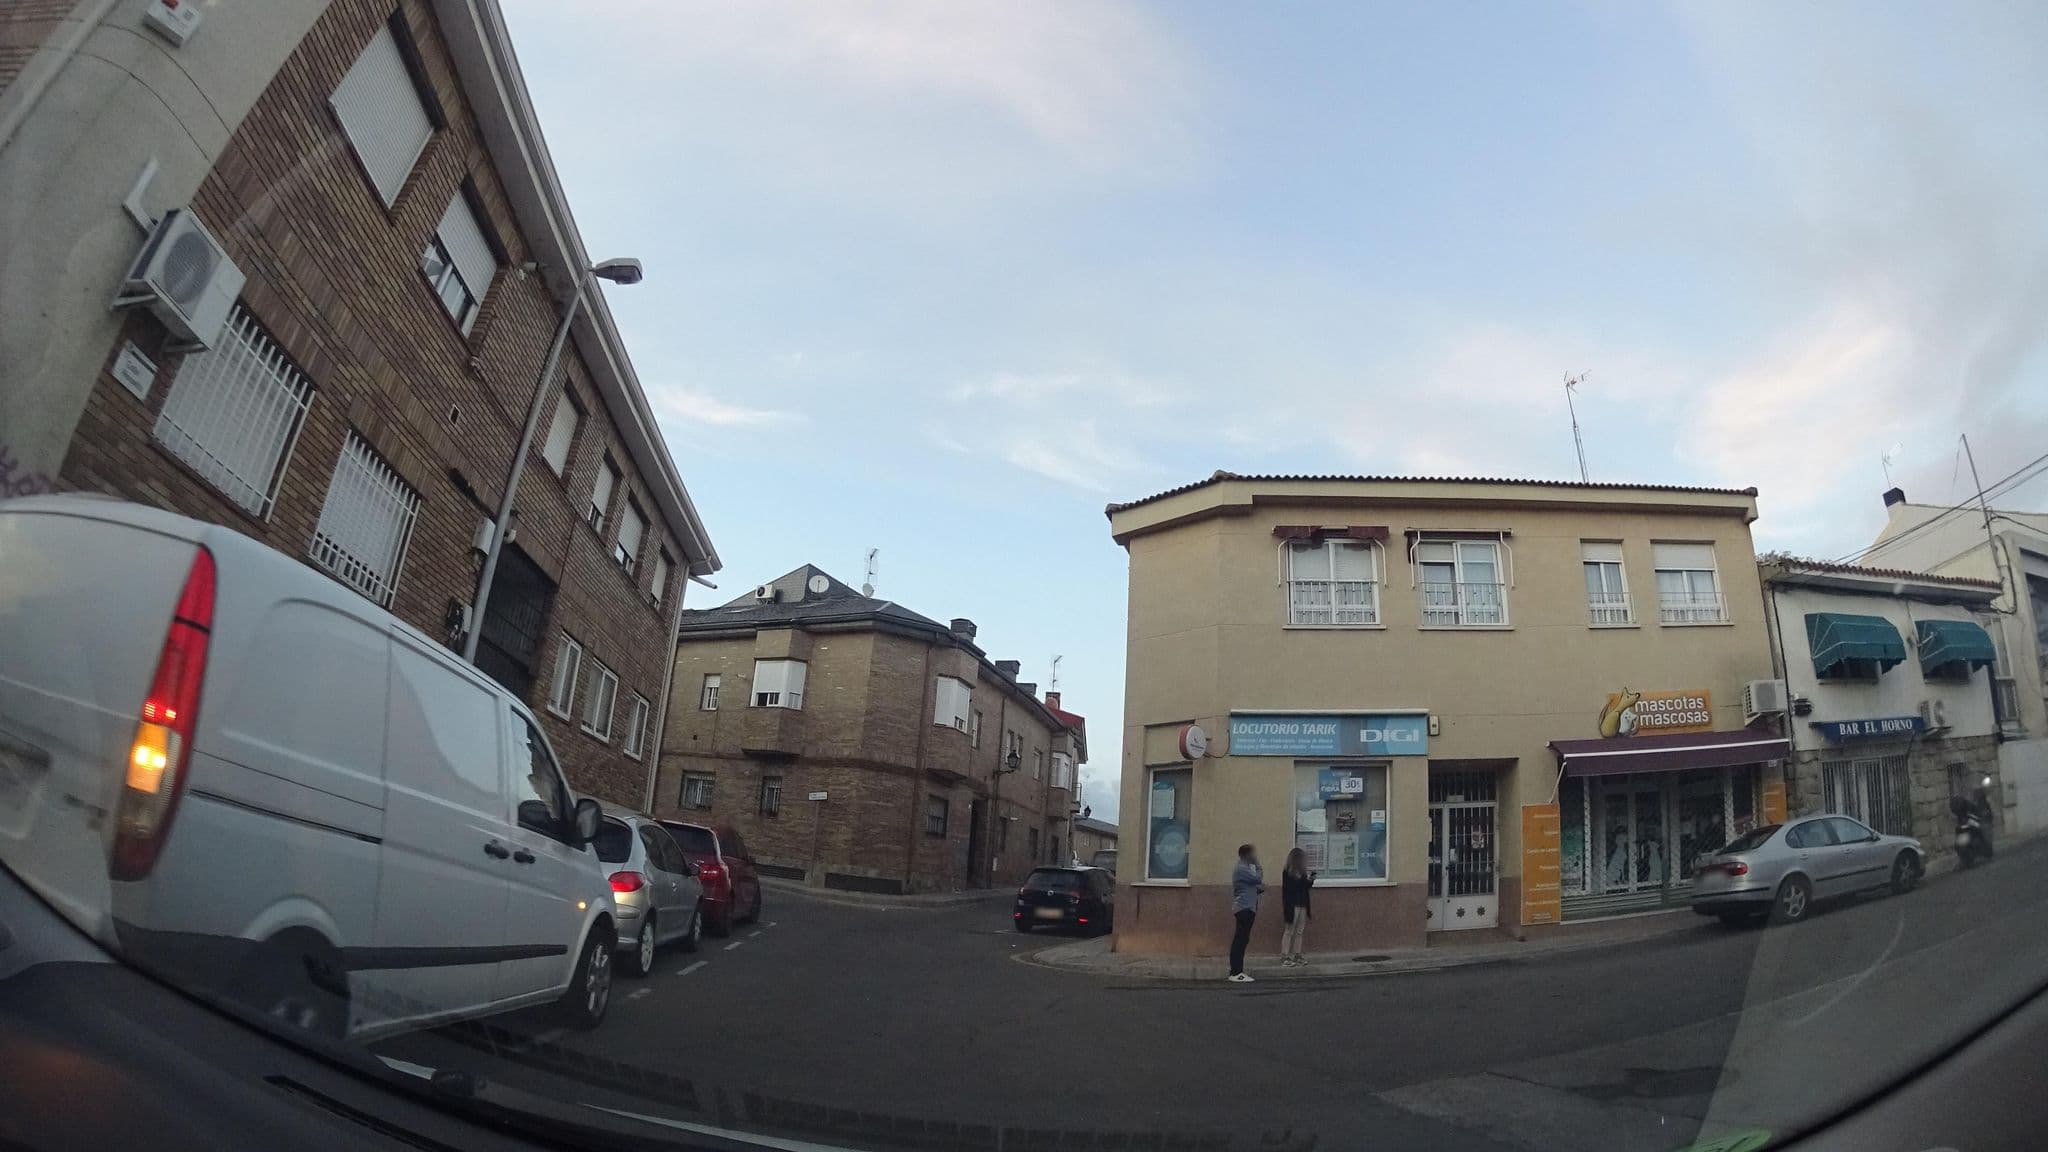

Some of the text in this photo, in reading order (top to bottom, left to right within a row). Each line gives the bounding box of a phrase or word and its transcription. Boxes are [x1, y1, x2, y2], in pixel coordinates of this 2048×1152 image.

[1635, 696, 1704, 712] mascotas
[1640, 711, 1709, 726] mascosas
[1232, 723, 1337, 735] LOCUTORIO TARIK
[1839, 719, 1913, 735] BAR EL HORNO
[1360, 729, 1419, 743] DIGI
